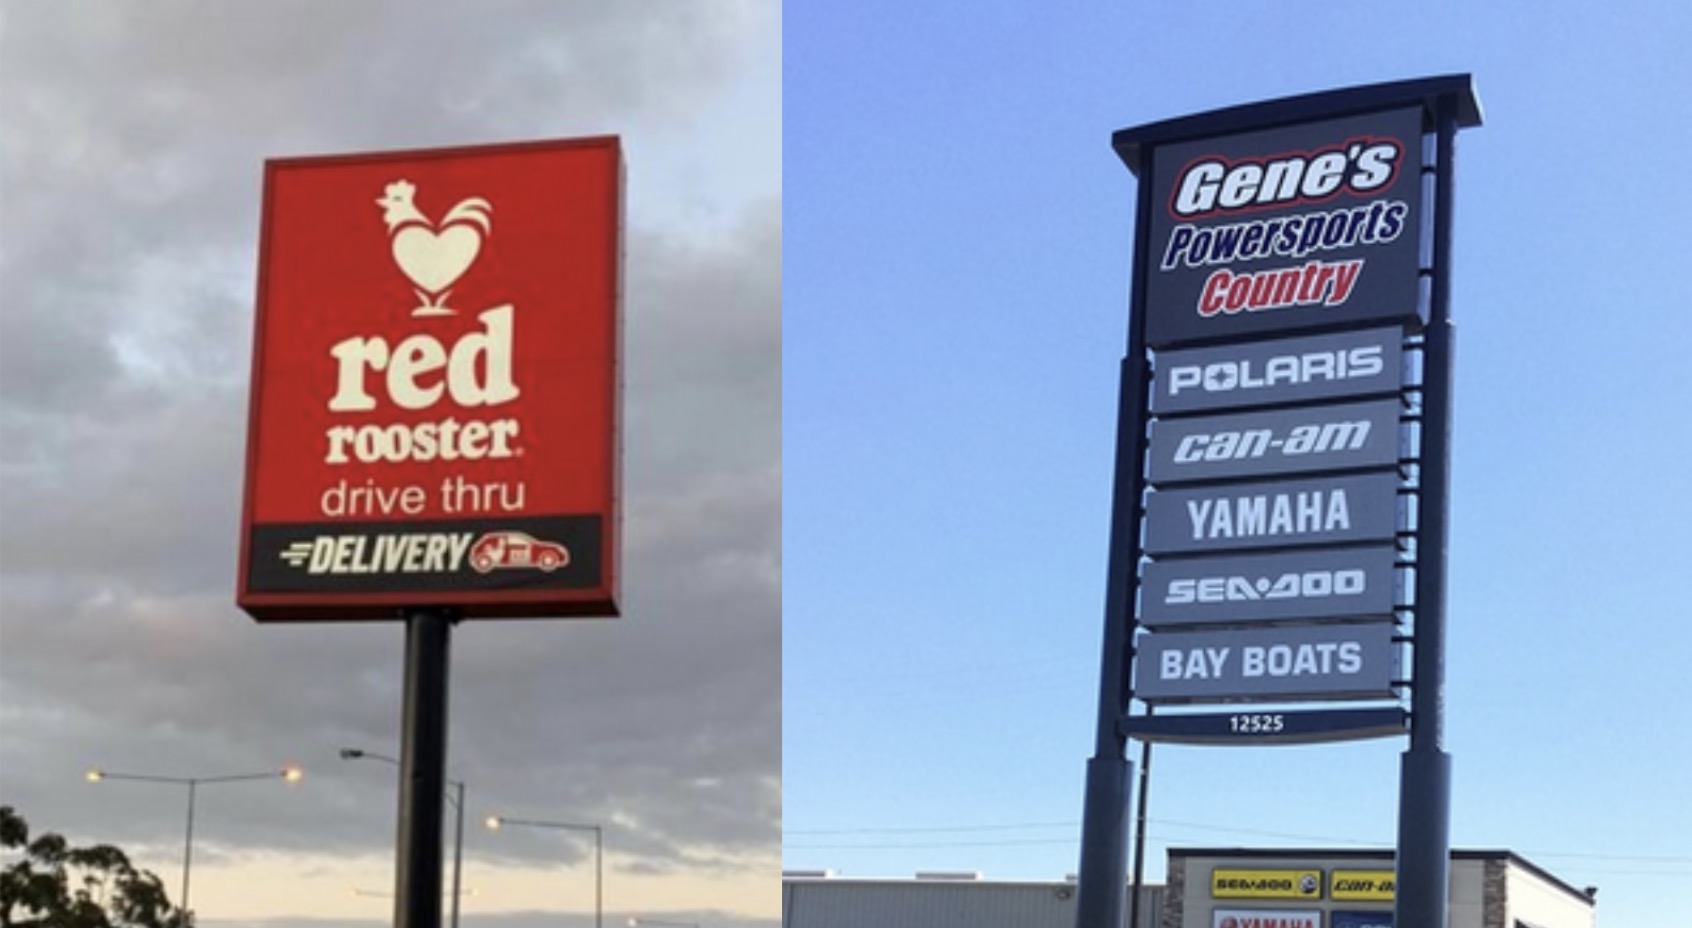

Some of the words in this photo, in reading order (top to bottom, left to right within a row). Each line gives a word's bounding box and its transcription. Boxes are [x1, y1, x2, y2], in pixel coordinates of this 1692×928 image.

[1174, 142, 1399, 216] Gene's
[1161, 201, 1408, 270] Powersports
[1198, 260, 1365, 317] Country
[327, 304, 520, 411] red
[1169, 346, 1384, 394] POLARIS
[1173, 420, 1371, 463] can-am
[321, 479, 425, 516] drive
[441, 476, 525, 511] thru
[1188, 489, 1350, 540] YAMAHA
[308, 533, 473, 573] DELIVERY
[1159, 648, 1229, 680] BAY
[1243, 642, 1362, 677] BOATS
[1230, 715, 1284, 732] 12525
